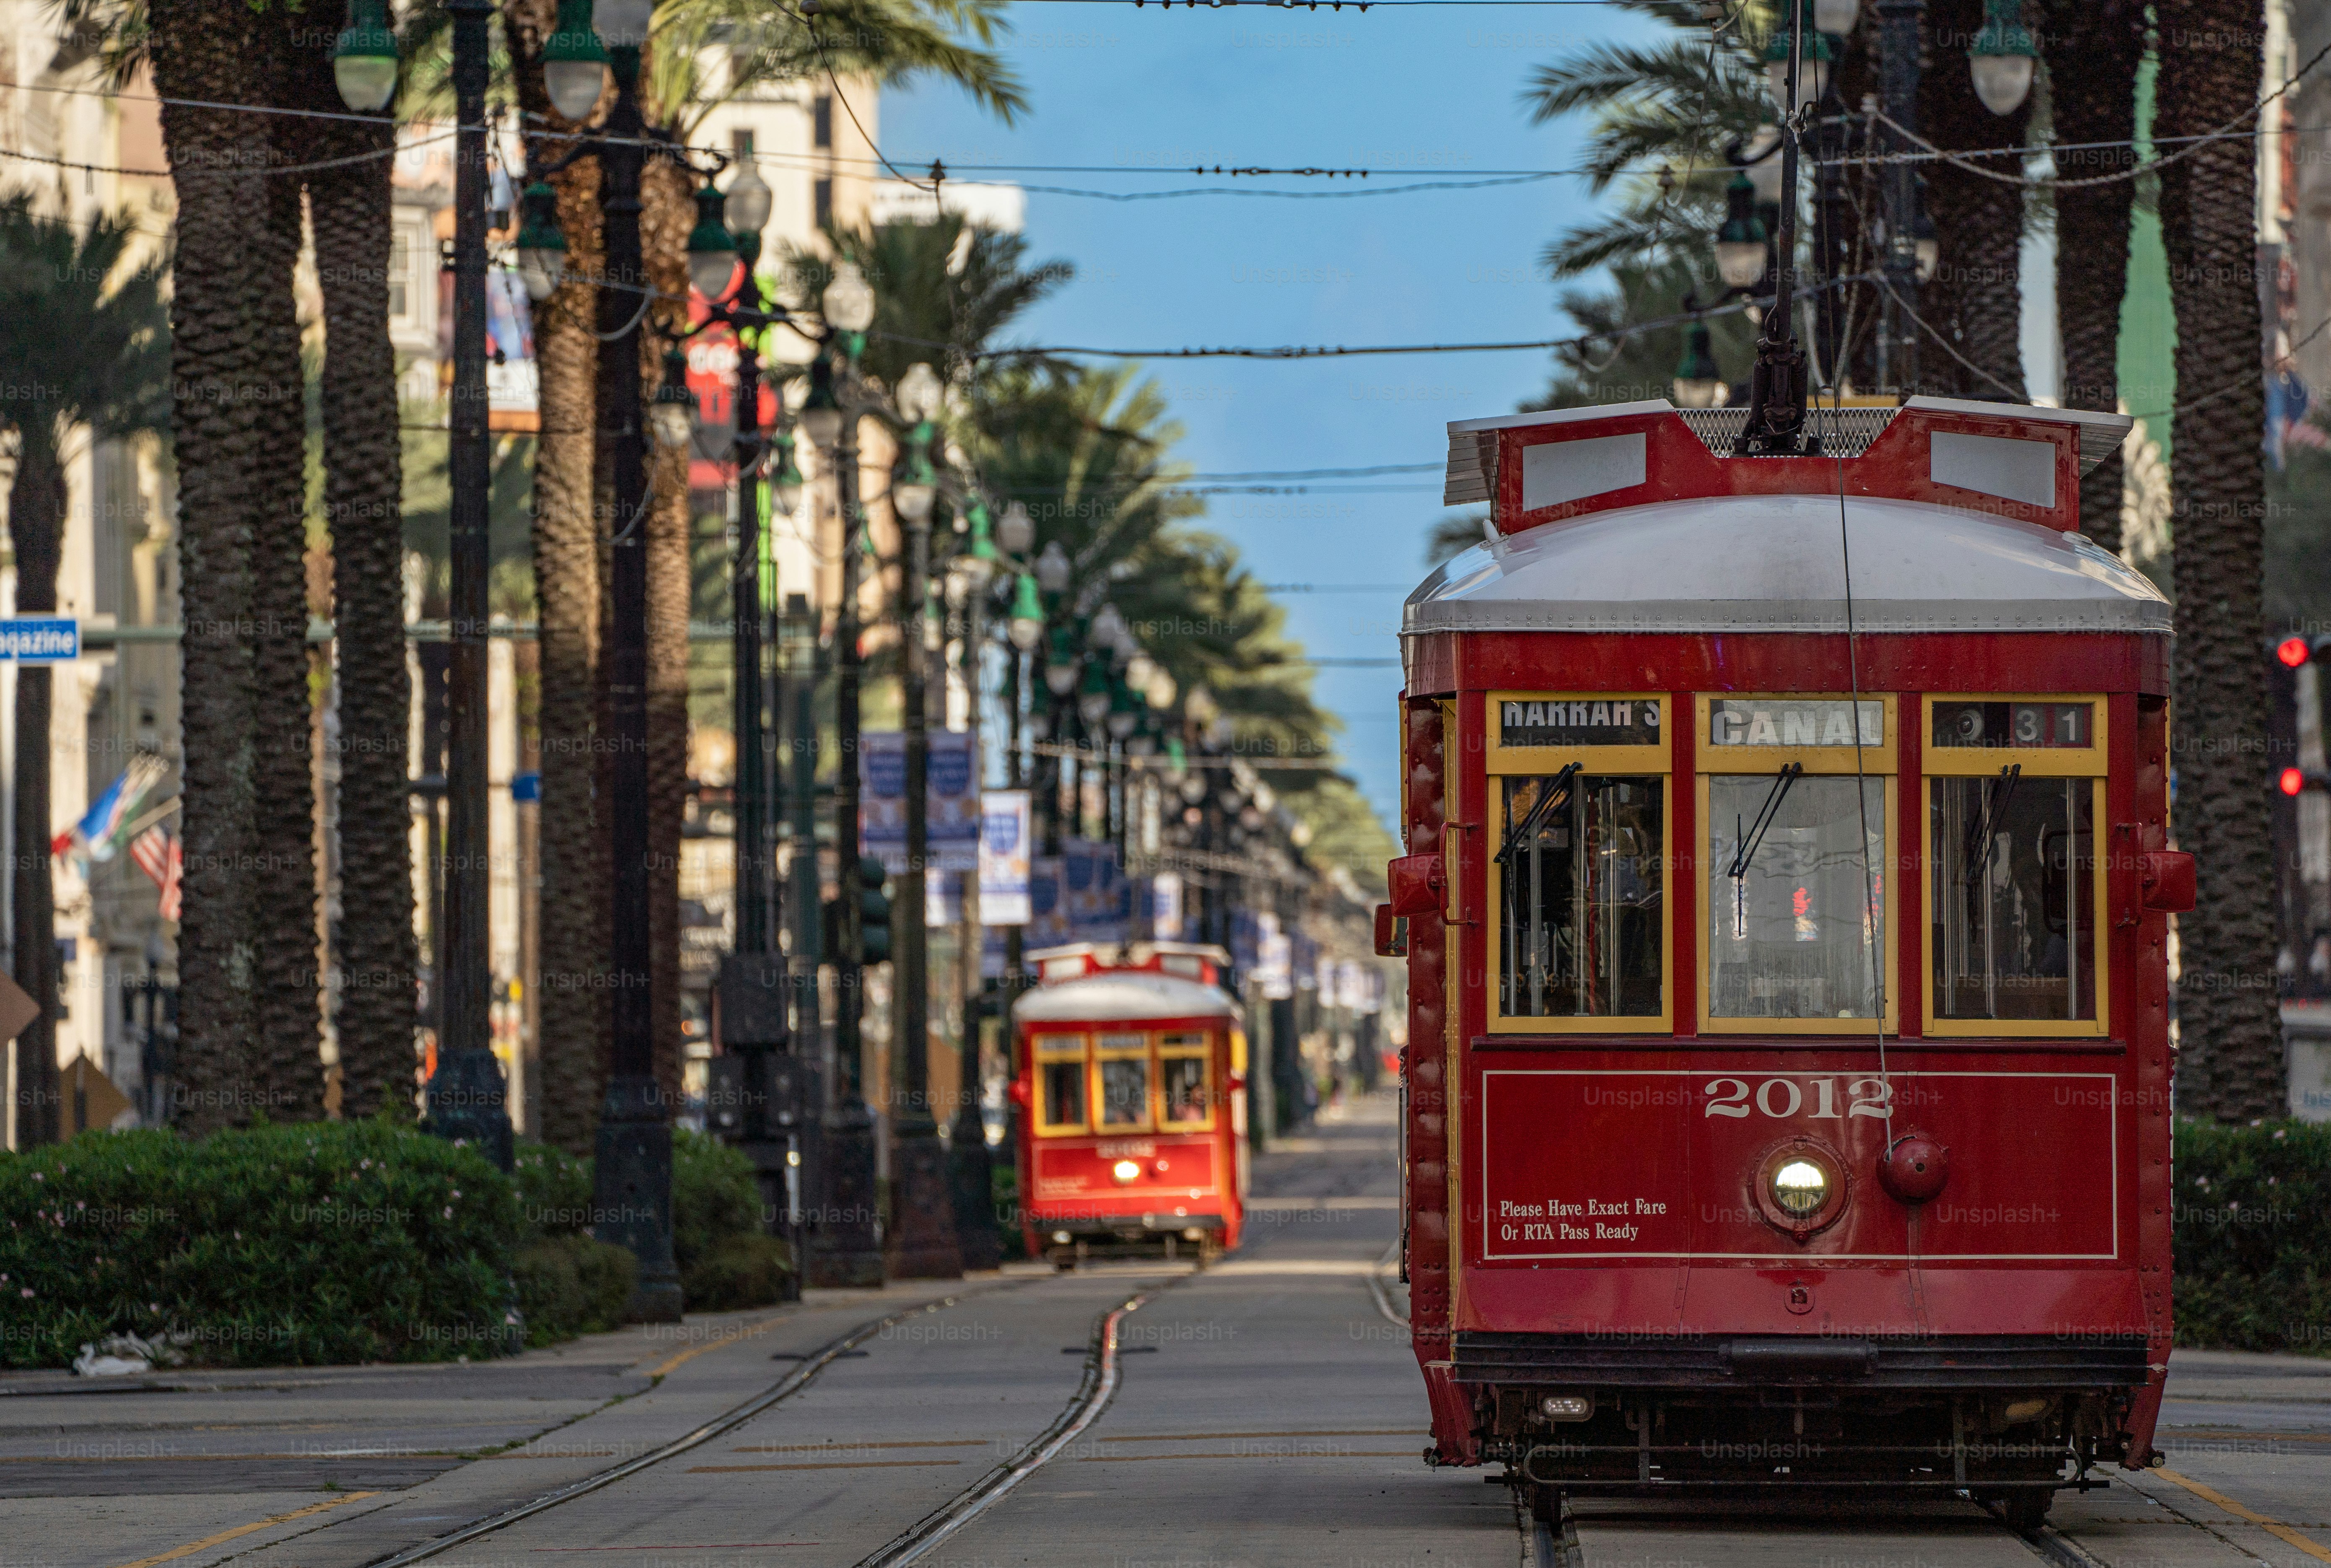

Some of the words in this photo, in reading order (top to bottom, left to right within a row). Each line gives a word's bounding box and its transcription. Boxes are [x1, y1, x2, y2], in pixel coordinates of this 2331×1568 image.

[1713, 711, 1882, 745] CANAL
[1705, 1079, 1893, 1118] 2012
[1500, 1201, 1542, 1217] Please
[1548, 1200, 1582, 1216] Have
[1588, 1199, 1629, 1215] Exact
[1635, 1198, 1666, 1215] Fare
[1501, 1224, 1518, 1240] Or
[1524, 1223, 1554, 1240] RTA
[1560, 1223, 1589, 1239] Pass
[1595, 1223, 1639, 1241] Ready
